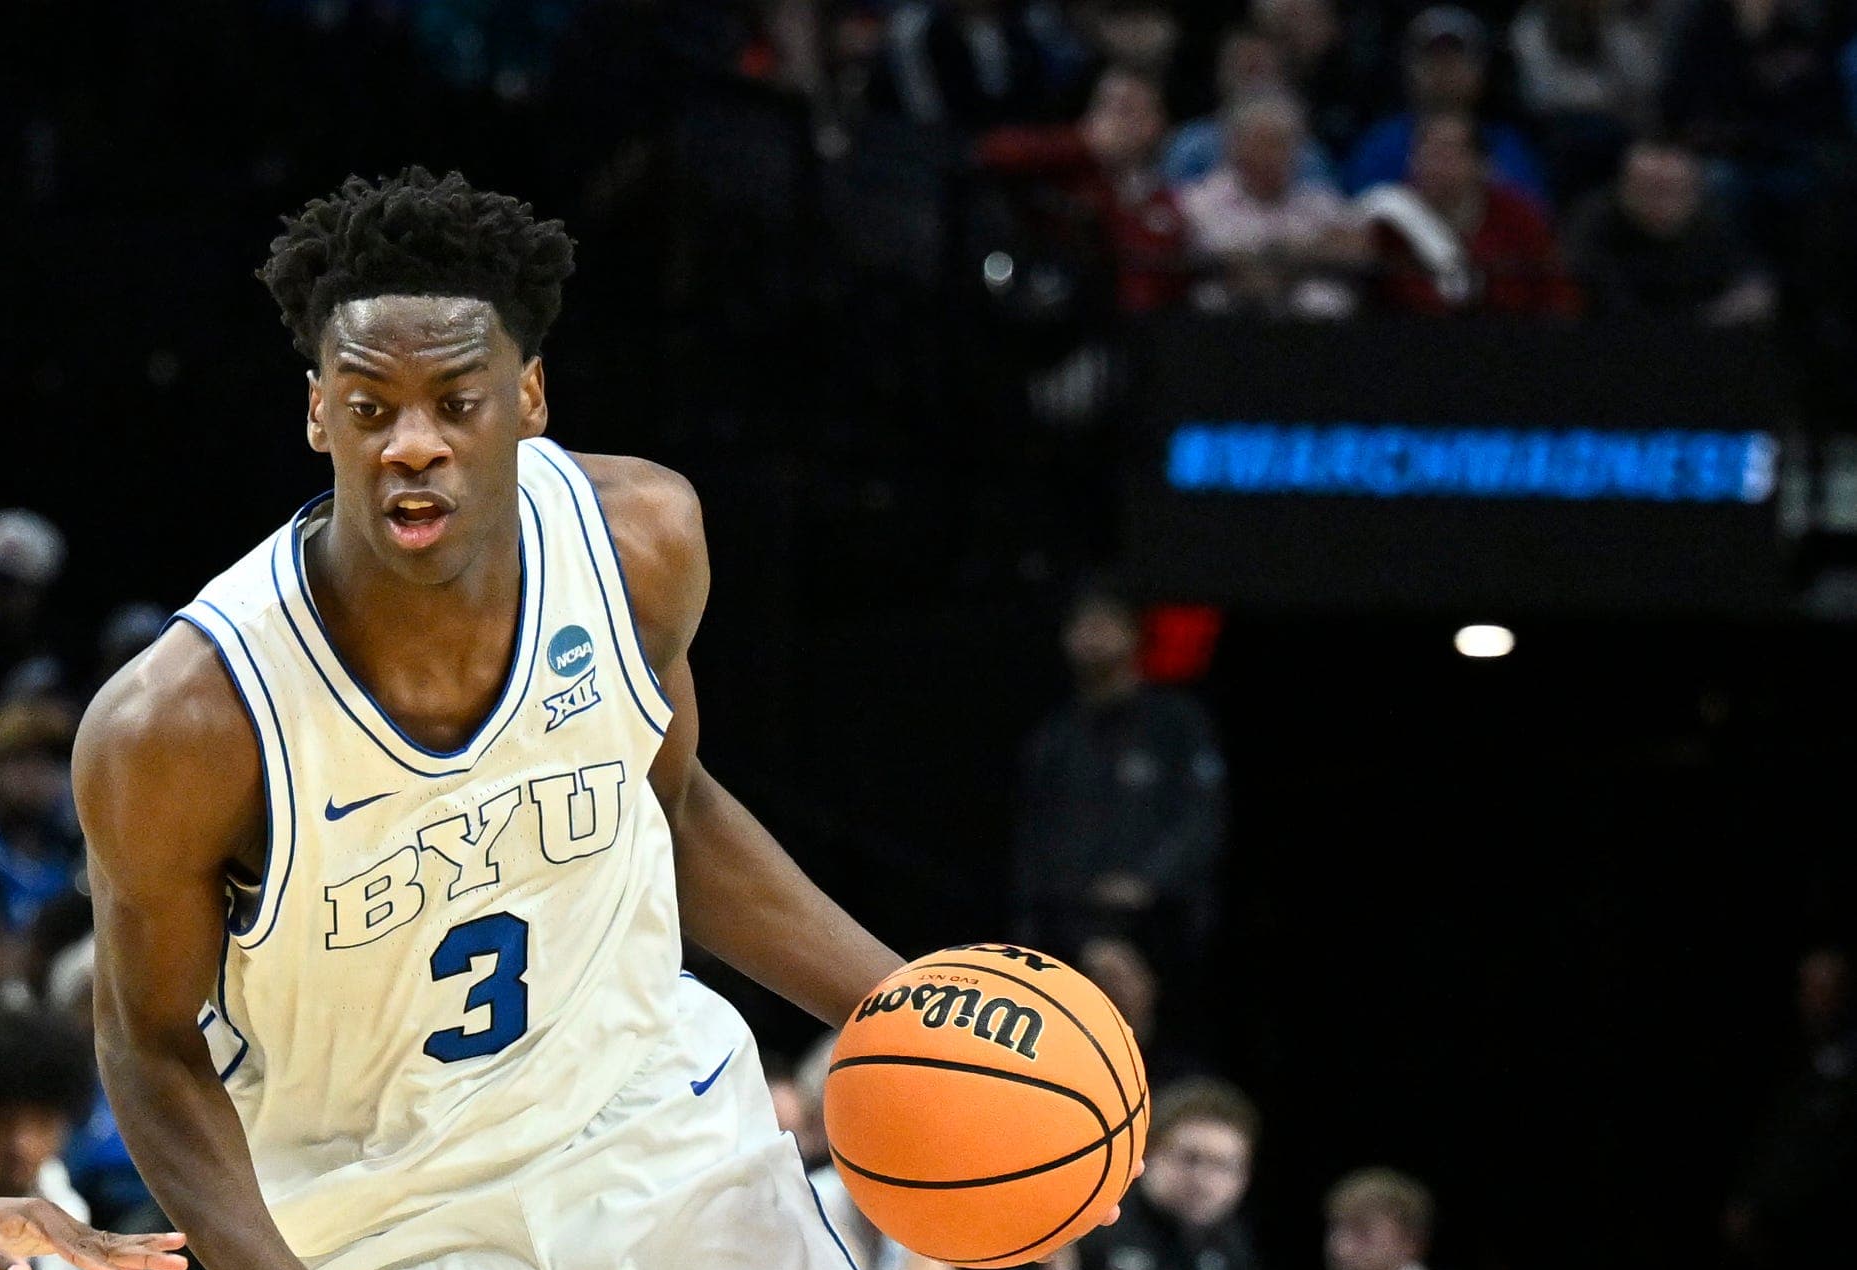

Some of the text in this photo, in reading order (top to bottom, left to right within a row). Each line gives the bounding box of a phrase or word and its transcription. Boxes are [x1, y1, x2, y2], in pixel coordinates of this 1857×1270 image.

[555, 641, 593, 670] NCAA
[543, 666, 600, 732] XII
[325, 761, 625, 949] BYU
[423, 911, 528, 1063] 3
[949, 975, 980, 985] EVO
[855, 983, 1044, 1060] Wilson
